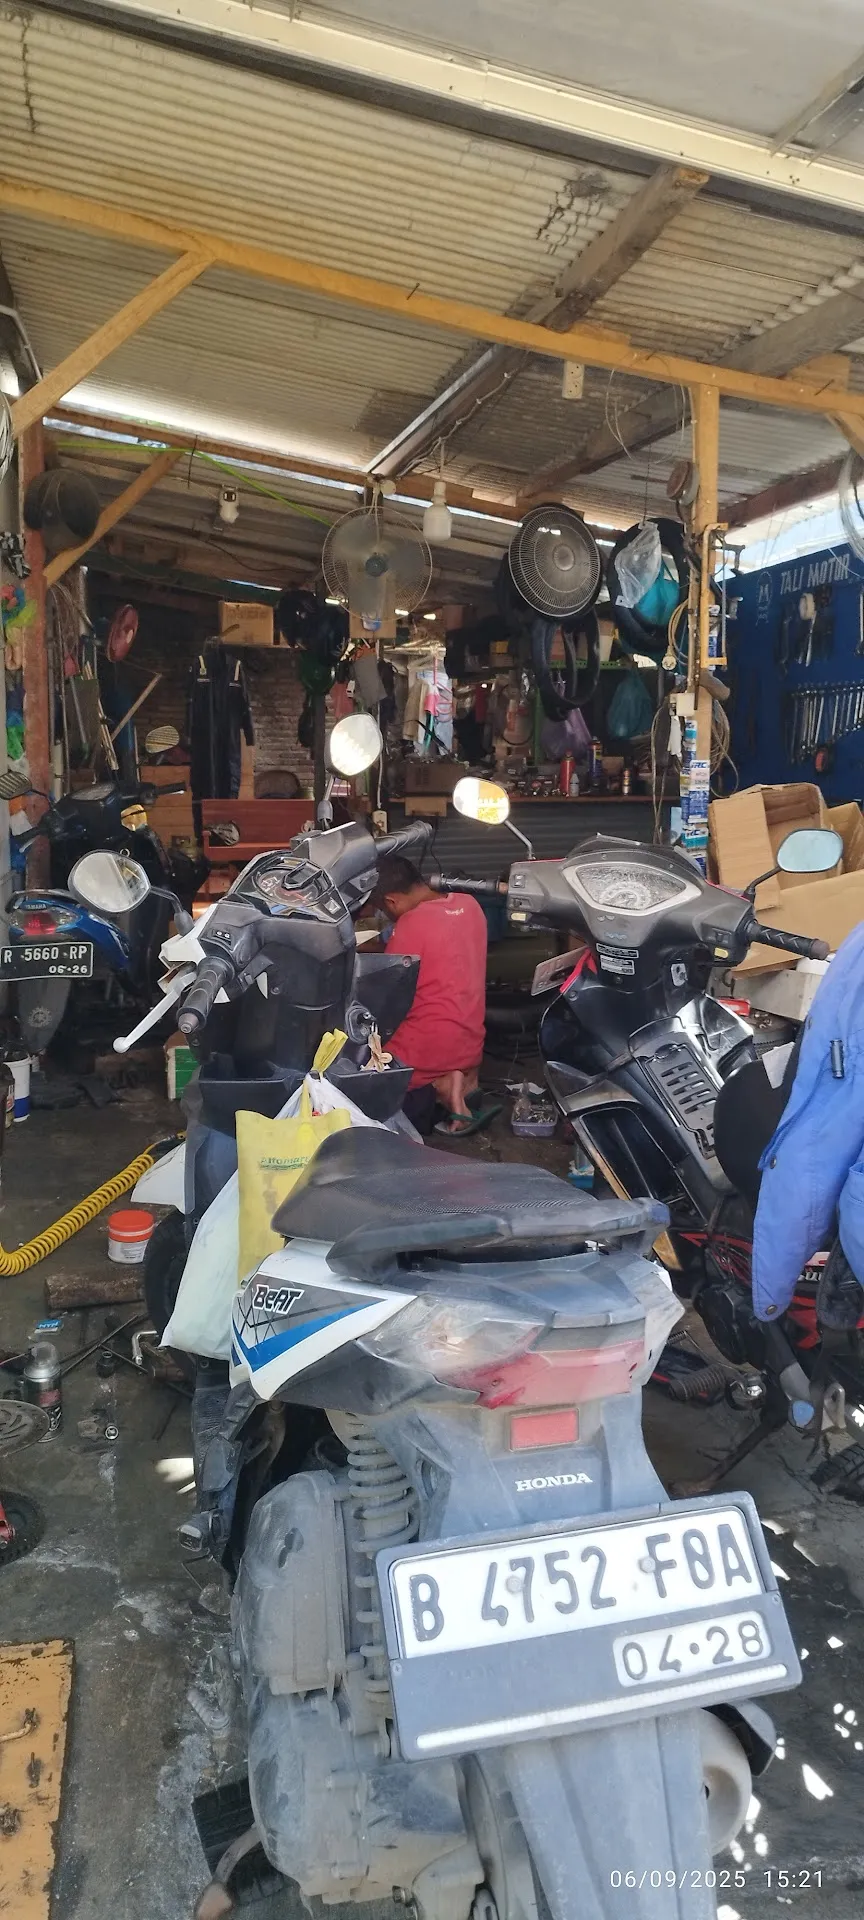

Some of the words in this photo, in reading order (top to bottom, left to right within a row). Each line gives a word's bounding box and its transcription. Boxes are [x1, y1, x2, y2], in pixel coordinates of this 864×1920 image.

[780, 566, 805, 596] TALI
[807, 553, 850, 588] MOTOR
[4, 949, 13, 963] R
[24, 946, 59, 961] 5660
[69, 945, 88, 960] RP
[514, 1472, 594, 1492] HONDA
[409, 1573, 445, 1643] B
[480, 1545, 617, 1627] 4752
